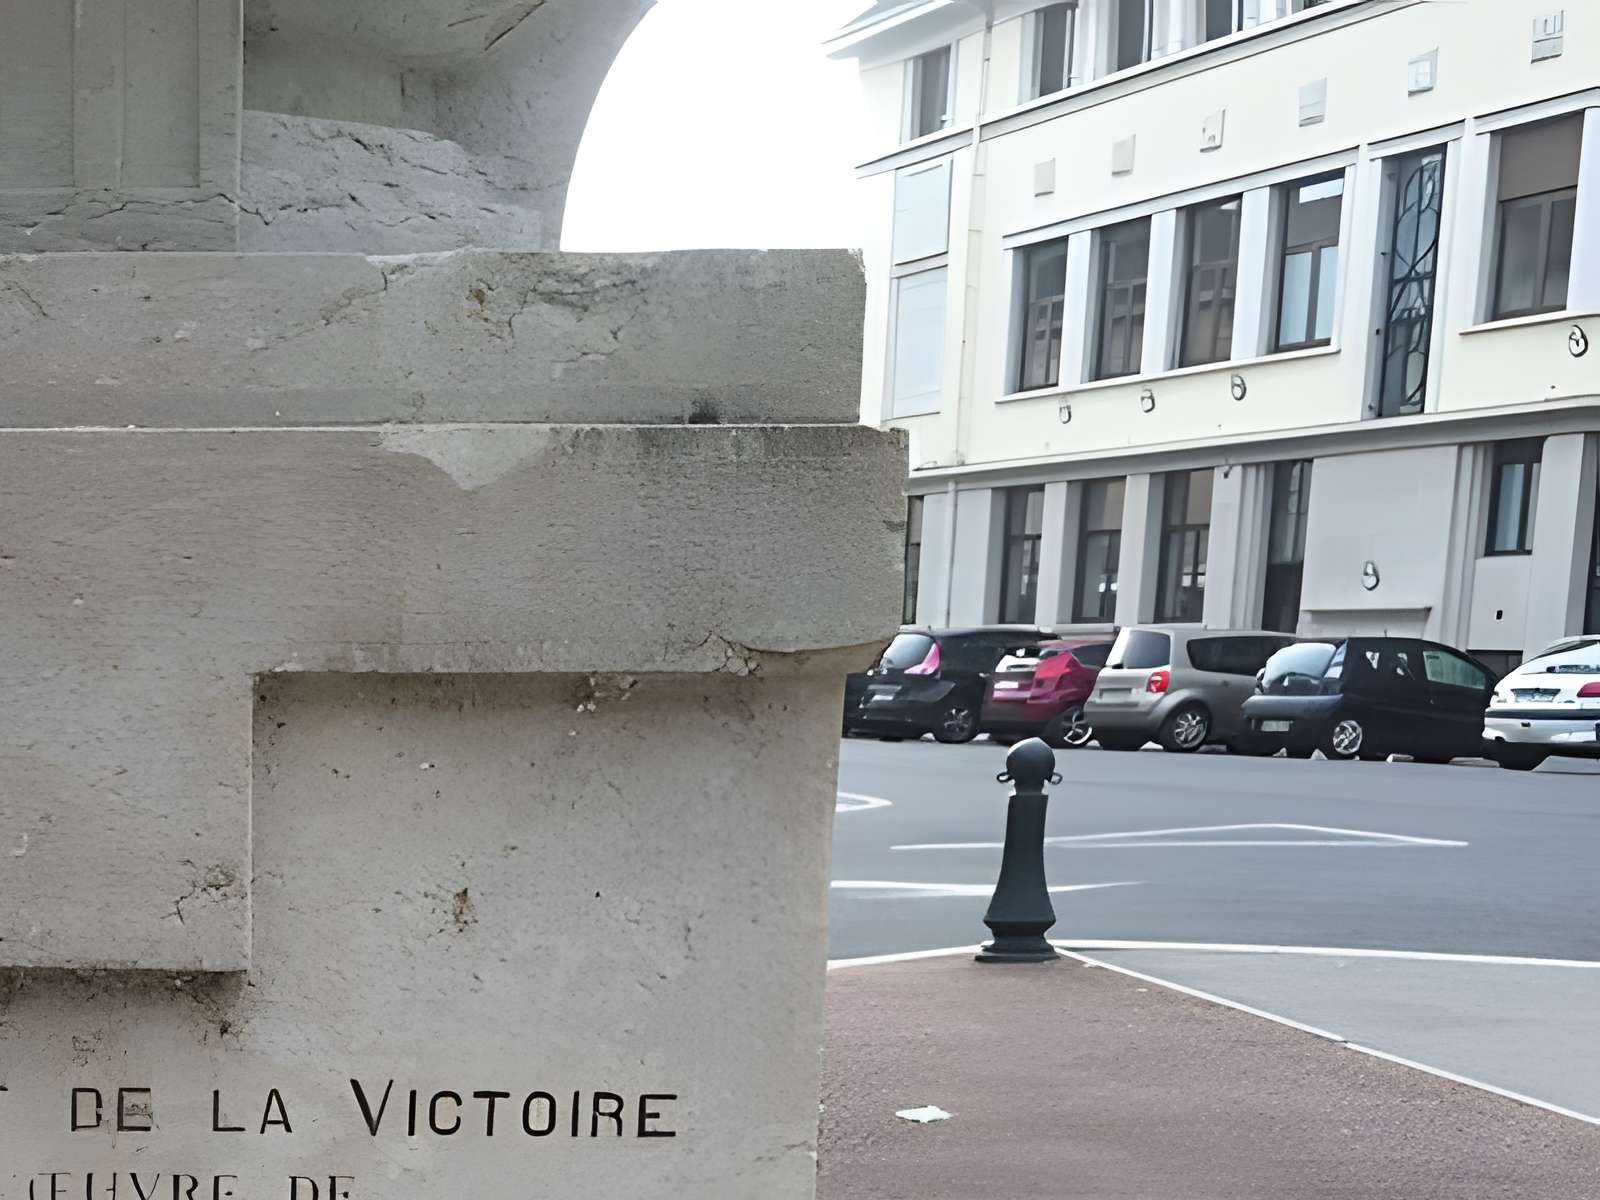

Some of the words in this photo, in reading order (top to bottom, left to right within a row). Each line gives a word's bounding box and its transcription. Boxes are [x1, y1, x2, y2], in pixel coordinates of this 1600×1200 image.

[71, 1086, 152, 1133] DE
[212, 1087, 293, 1135] LA
[350, 1078, 679, 1138] VICTOIRE
